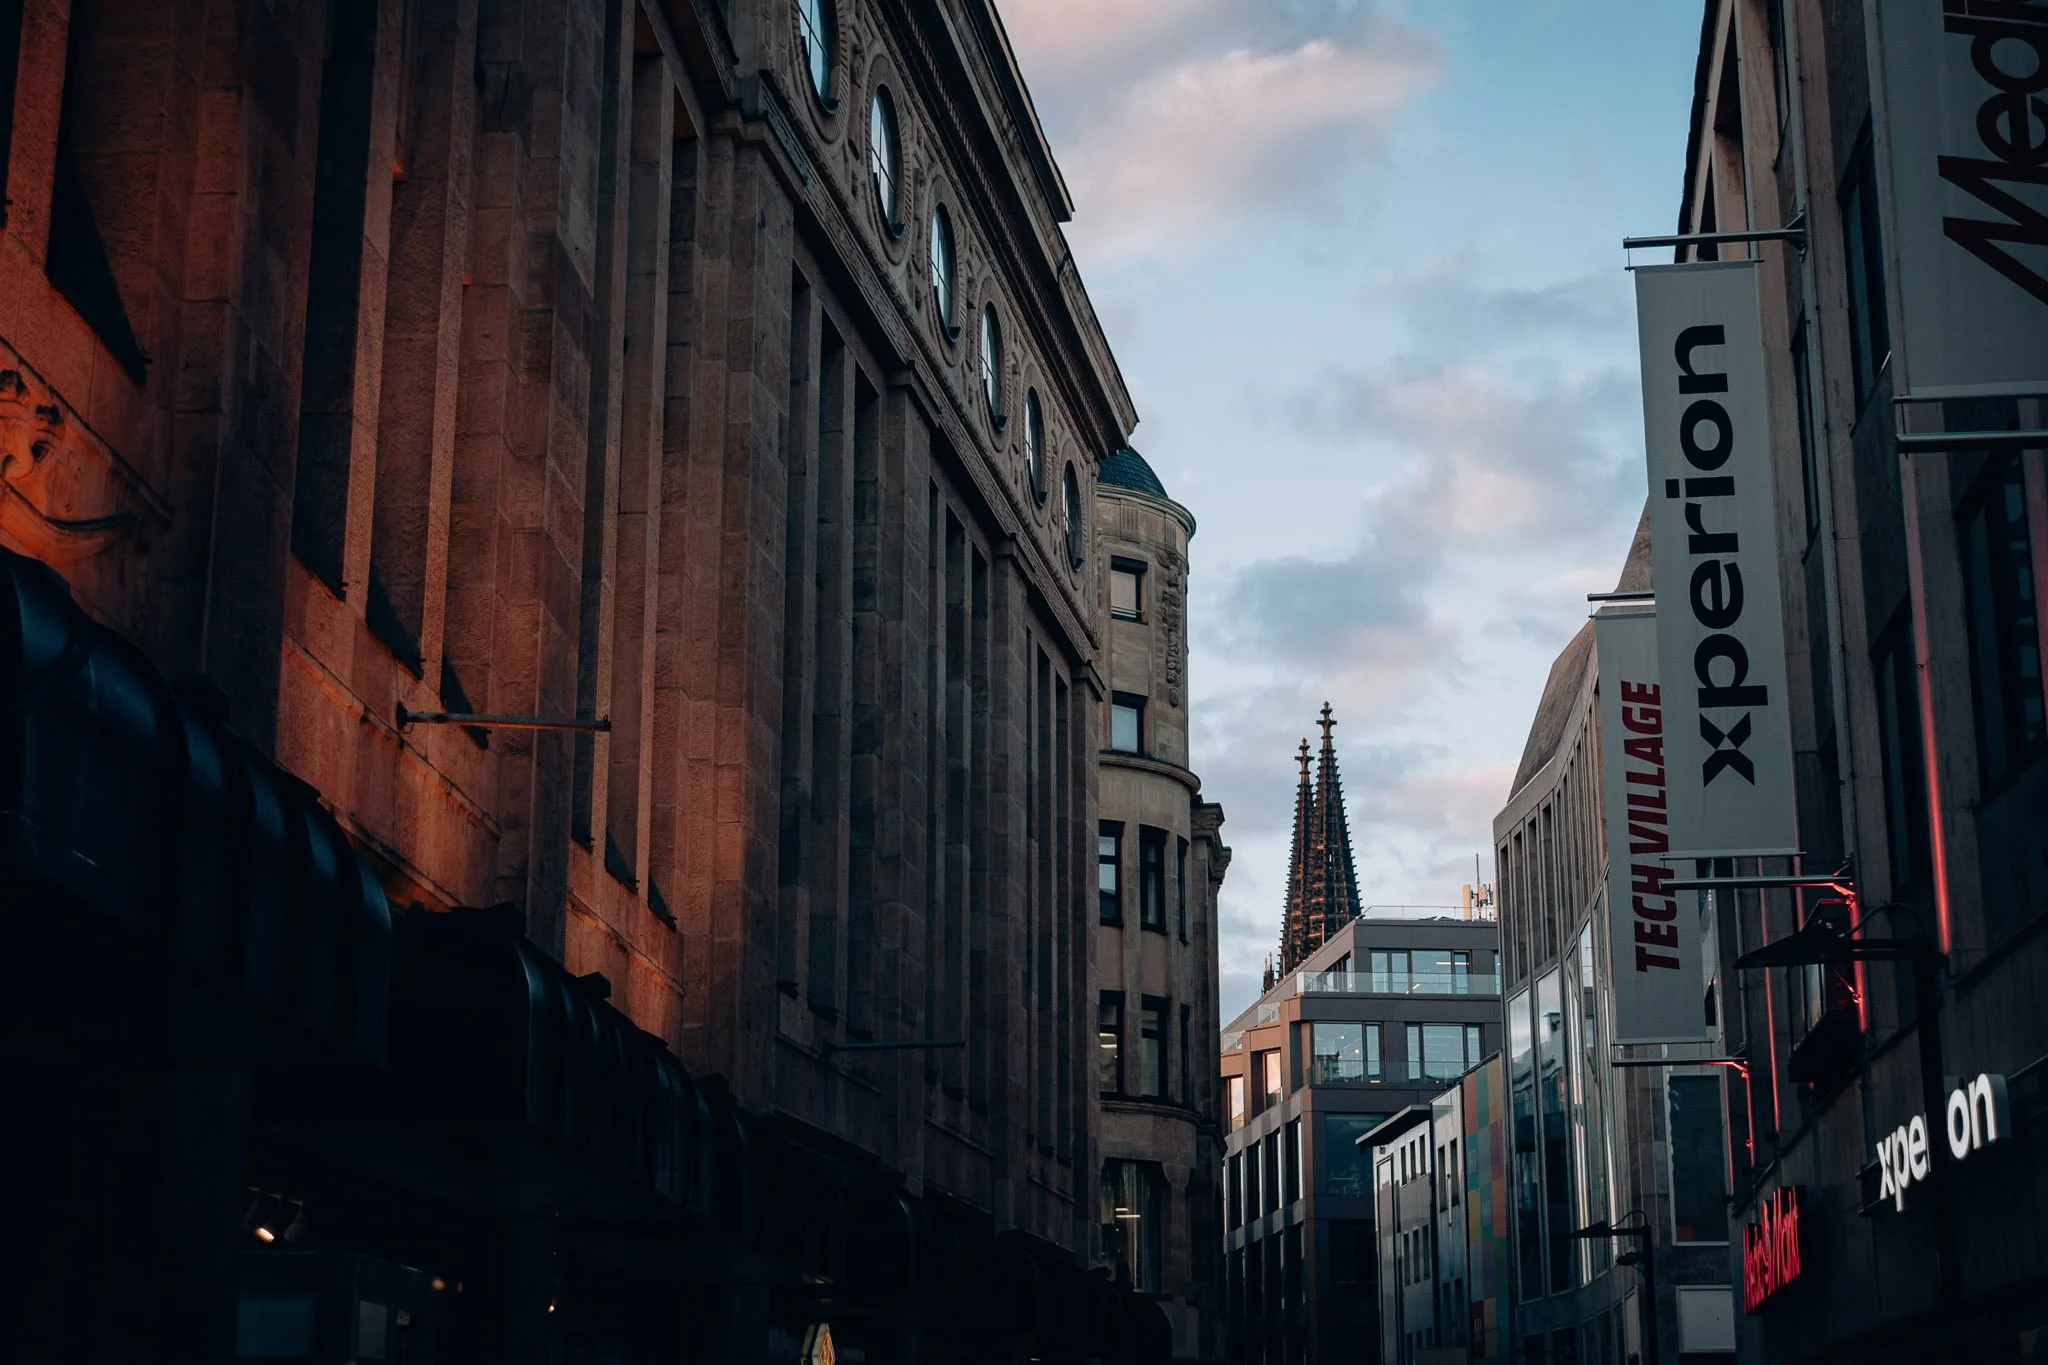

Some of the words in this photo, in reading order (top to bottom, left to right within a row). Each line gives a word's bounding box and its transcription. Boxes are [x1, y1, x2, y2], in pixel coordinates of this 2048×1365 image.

[1665, 324, 1768, 787] xperion
[1621, 680, 1670, 854] VILLAGE
[1631, 863, 1680, 972] TECH
[1876, 1073, 1999, 1213] xpeon
